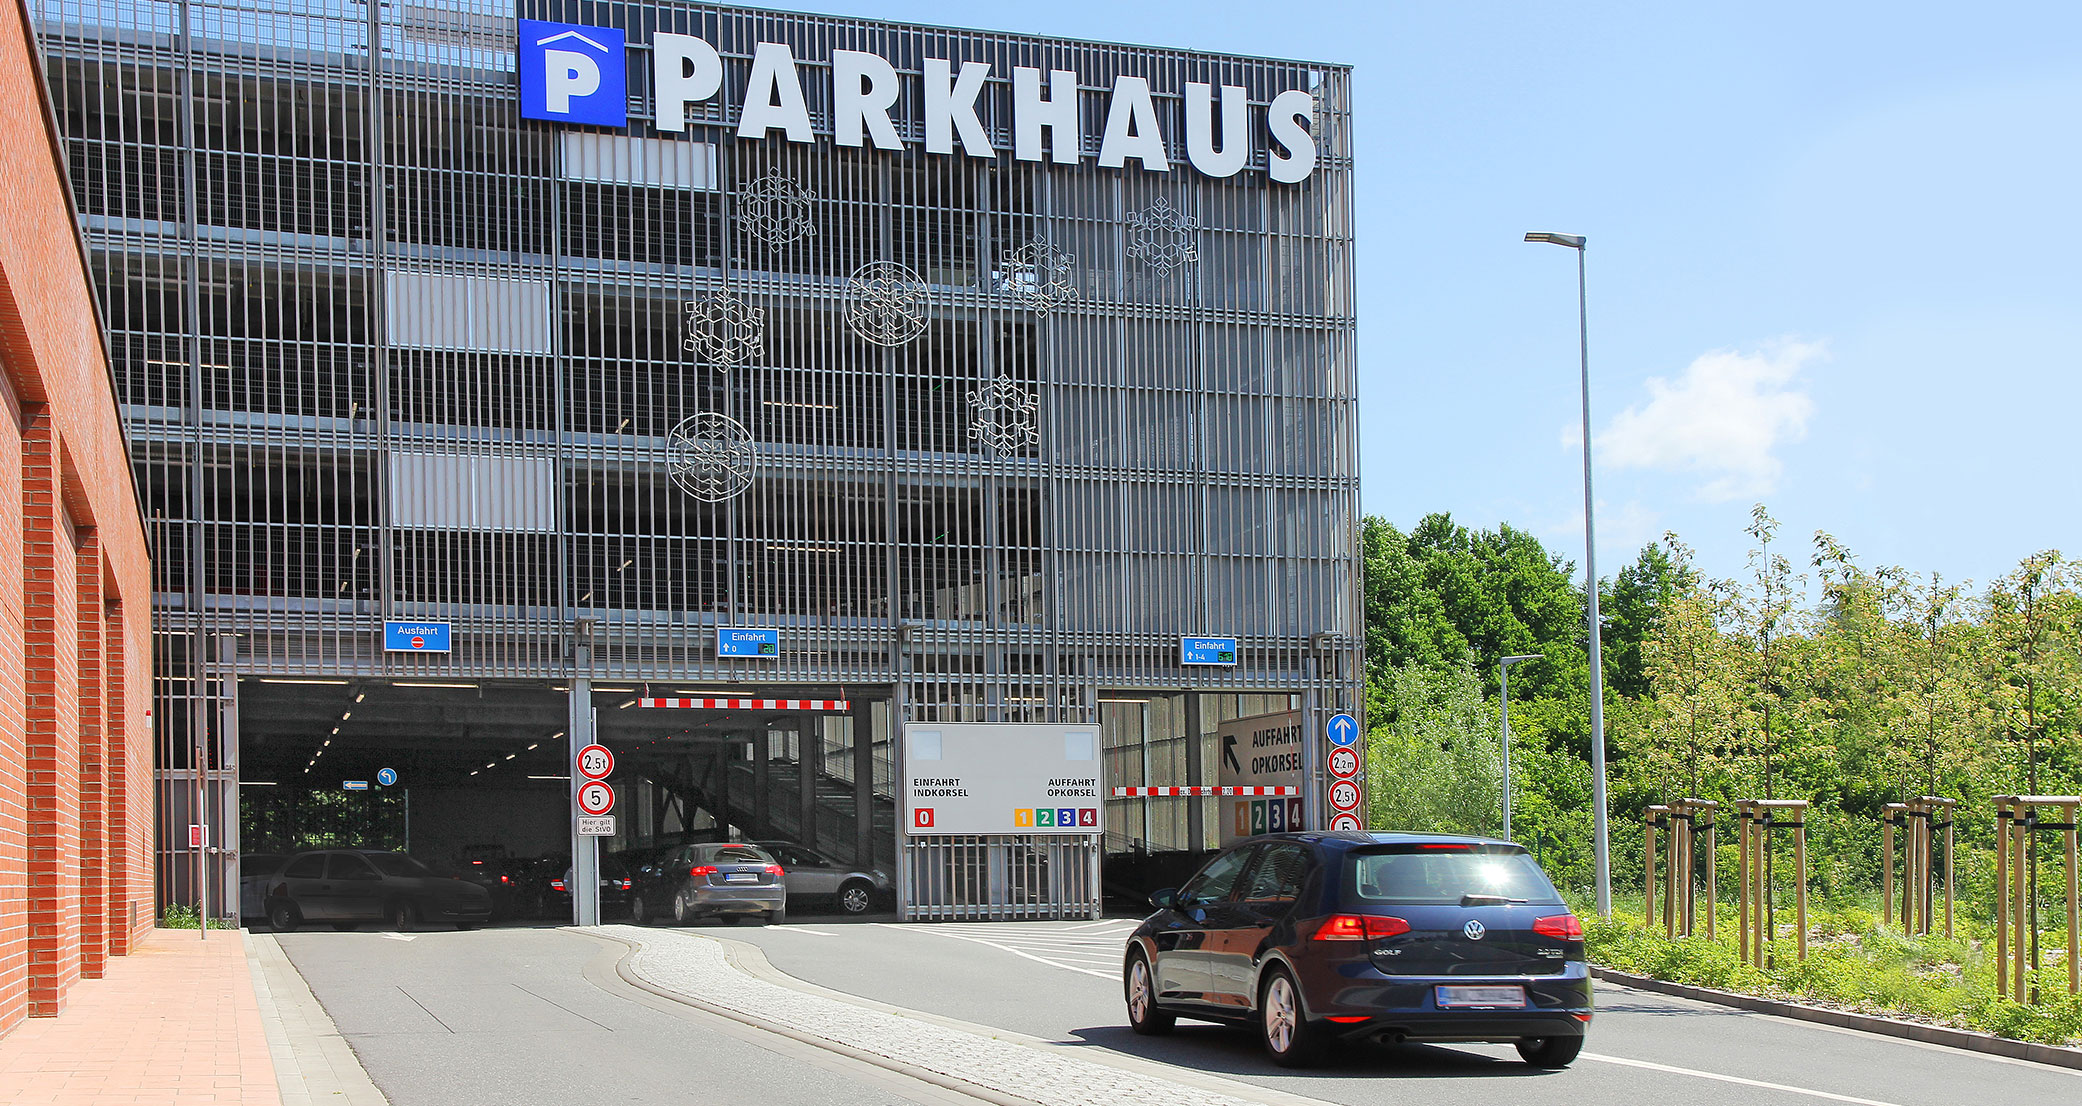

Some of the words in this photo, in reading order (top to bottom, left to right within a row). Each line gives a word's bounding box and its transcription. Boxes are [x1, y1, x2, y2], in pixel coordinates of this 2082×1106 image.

[545, 48, 601, 114] P
[653, 31, 1317, 185] PARKHAUS
[397, 625, 438, 635] Ausfahrt
[731, 632, 766, 641] Einfahrt
[1194, 641, 1225, 650] Einfahrt
[1252, 725, 1302, 748] AUFFAHRT
[1251, 752, 1302, 775] OPKØRSEL
[913, 778, 960, 787] EINFAHRT
[1048, 778, 1096, 787] AUFFAHRT
[591, 790, 601, 806] 5
[913, 788, 969, 797] INDKØRSEL
[1047, 788, 1096, 797] OPKØRSEL
[919, 810, 930, 826] 0
[1019, 811, 1028, 825] 1
[1040, 811, 1050, 825] 2
[1062, 811, 1072, 825] 3
[1082, 811, 1093, 825] 4
[1239, 806, 1245, 831] 1
[1255, 805, 1263, 830] 2
[1272, 803, 1281, 829] 3
[1291, 802, 1300, 828] 4
